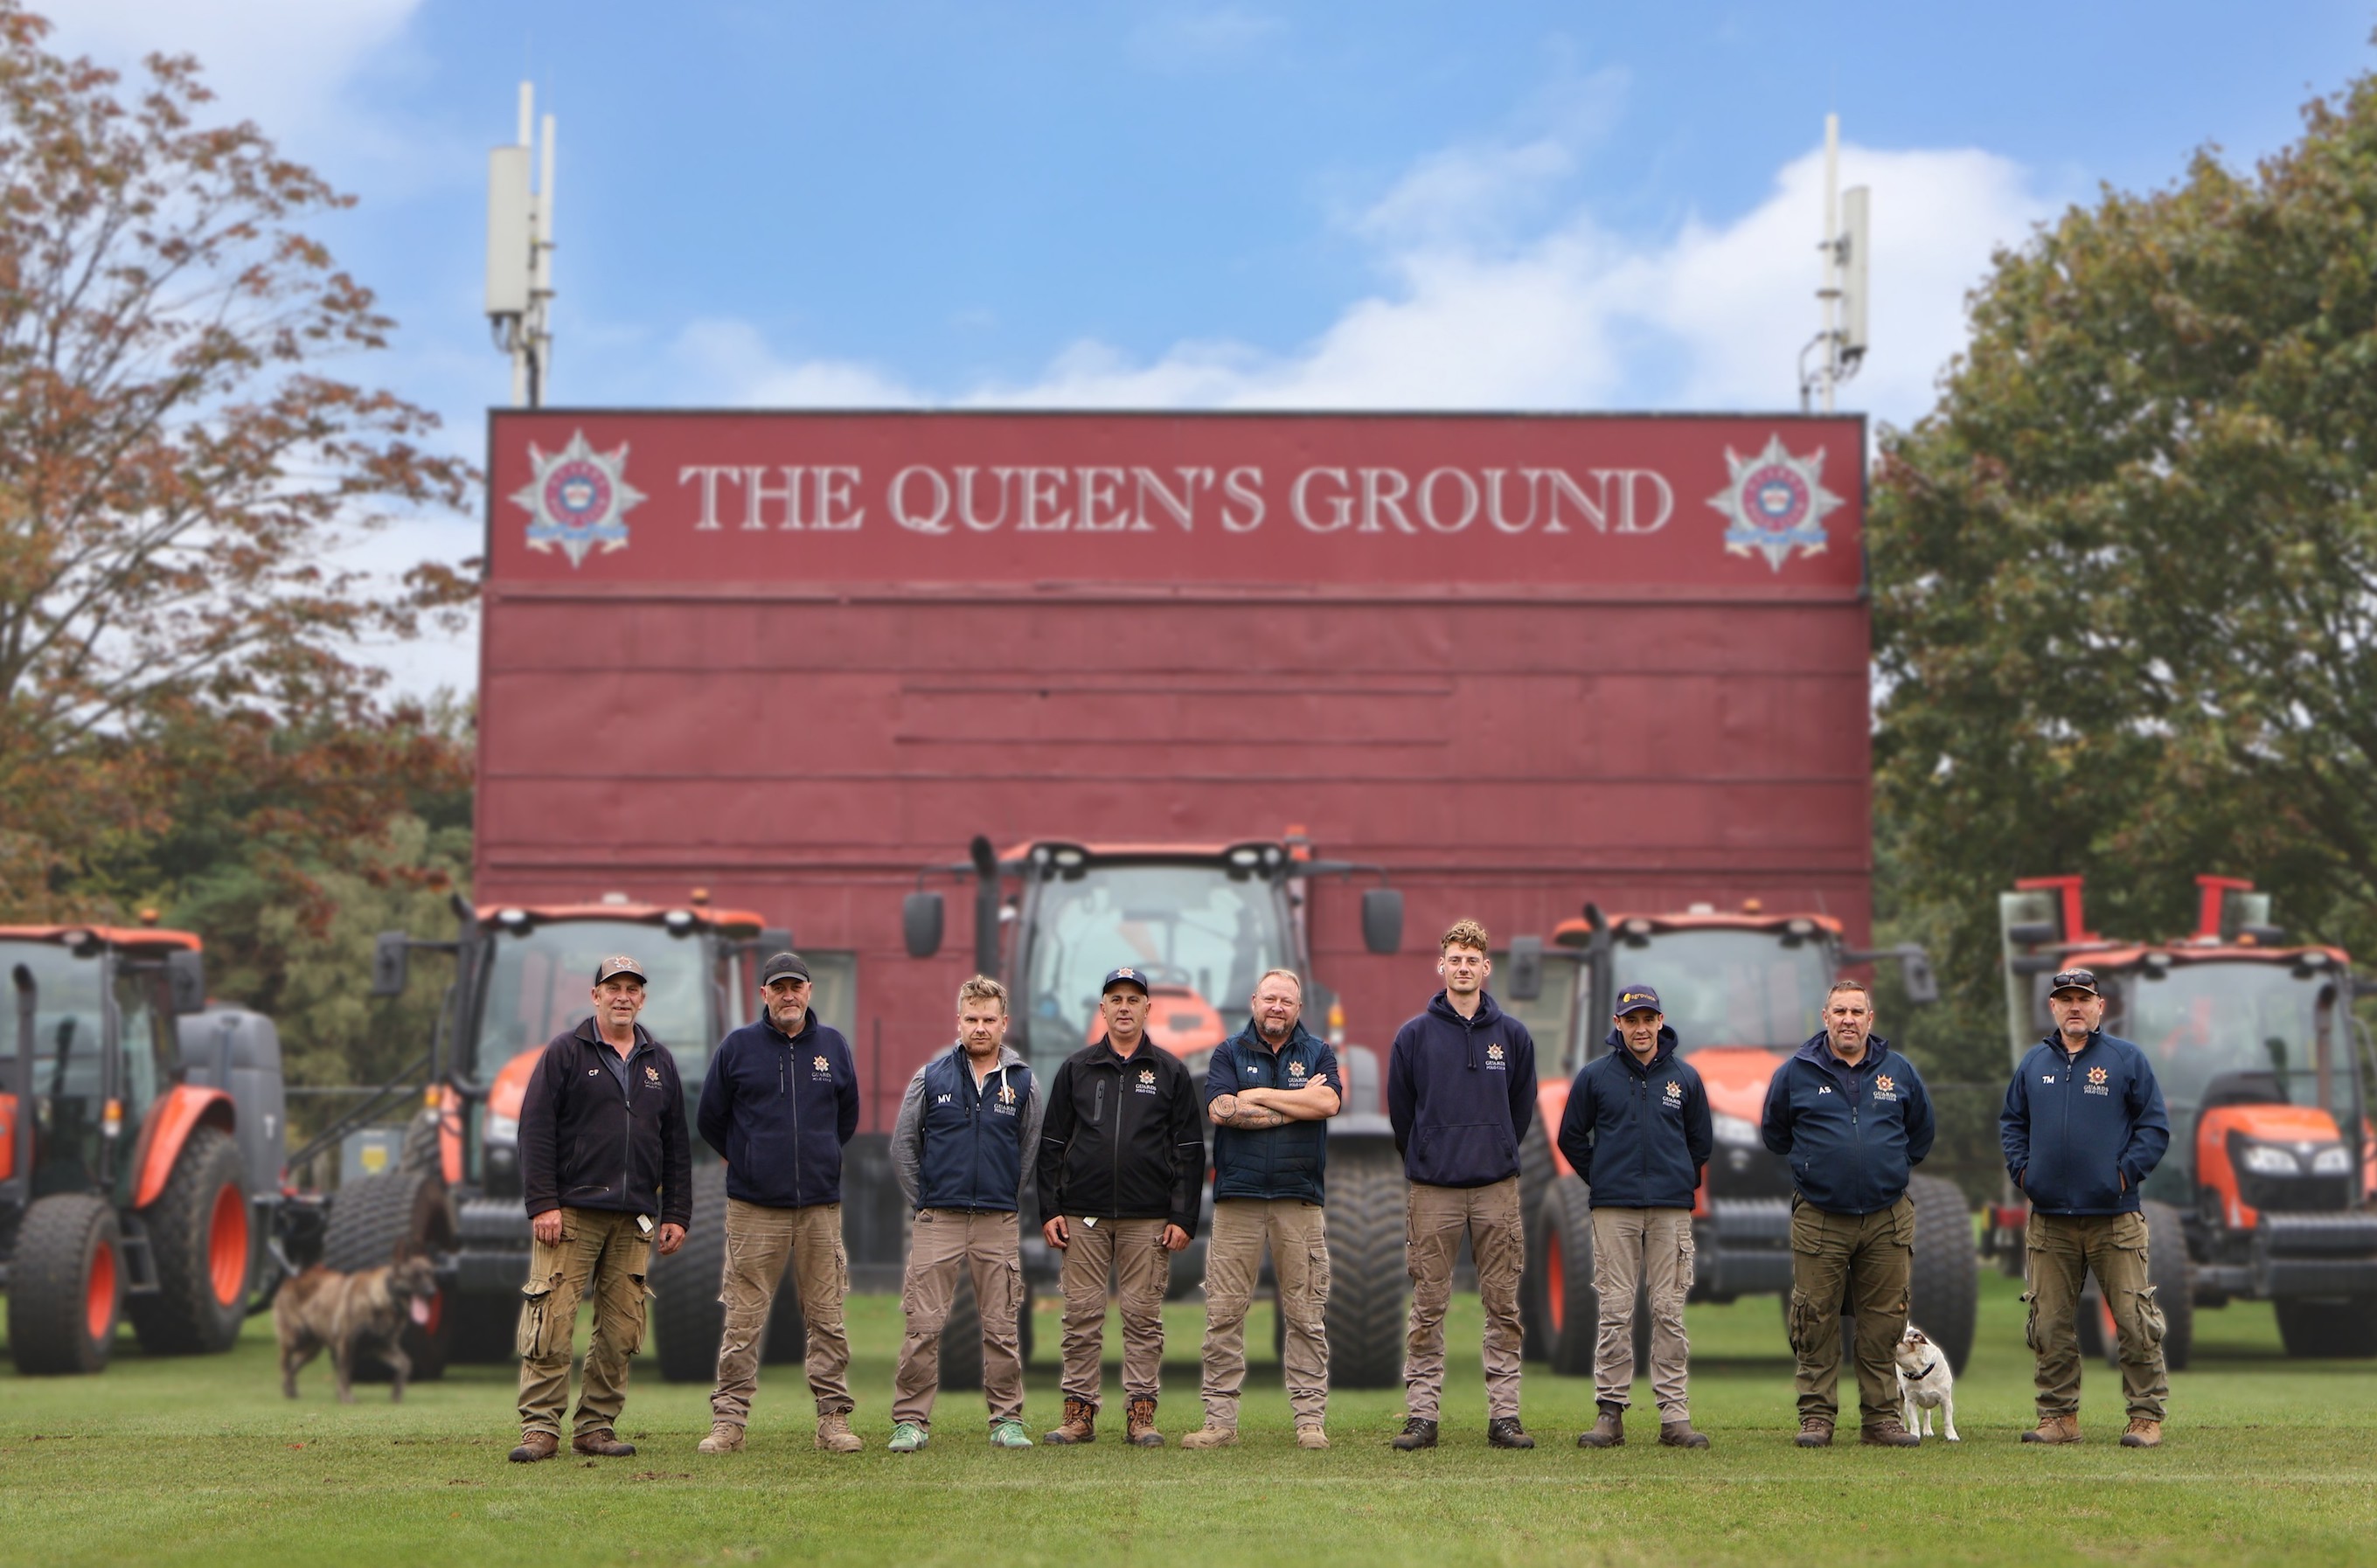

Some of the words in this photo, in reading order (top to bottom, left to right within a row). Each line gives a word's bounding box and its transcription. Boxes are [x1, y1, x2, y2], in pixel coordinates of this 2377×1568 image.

[678, 465, 865, 531] THE
[886, 465, 1267, 535] QUEEN'S
[1289, 466, 1675, 535] GROUND
[937, 1093, 952, 1104] MV
